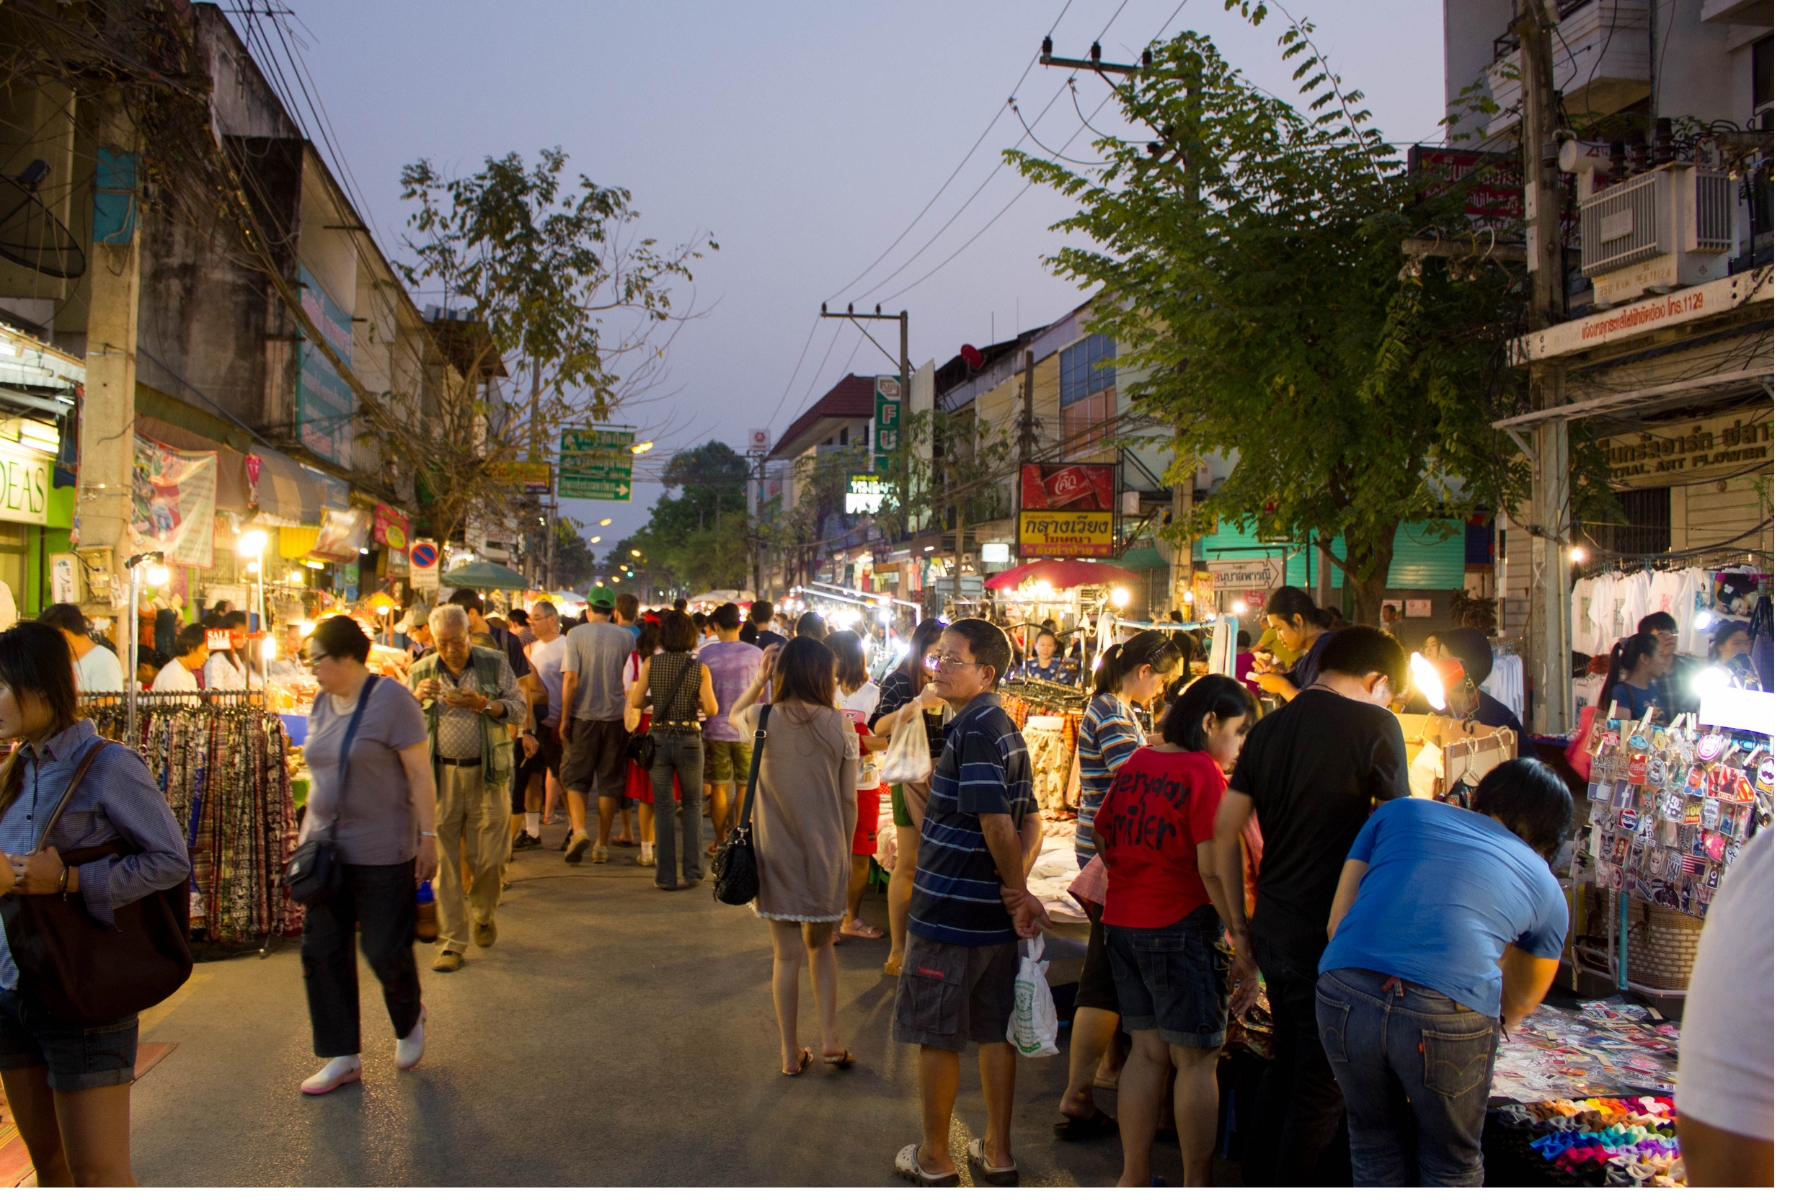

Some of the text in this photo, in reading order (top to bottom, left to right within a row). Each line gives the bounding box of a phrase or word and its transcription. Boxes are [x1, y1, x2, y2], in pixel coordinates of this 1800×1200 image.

[1655, 457, 1687, 473] ART
[1691, 446, 1767, 468] FLOWER
[1024, 515, 1110, 534] กลางเวียง
[207, 629, 231, 640] SALE
[1621, 813, 1638, 824] PEPSI
